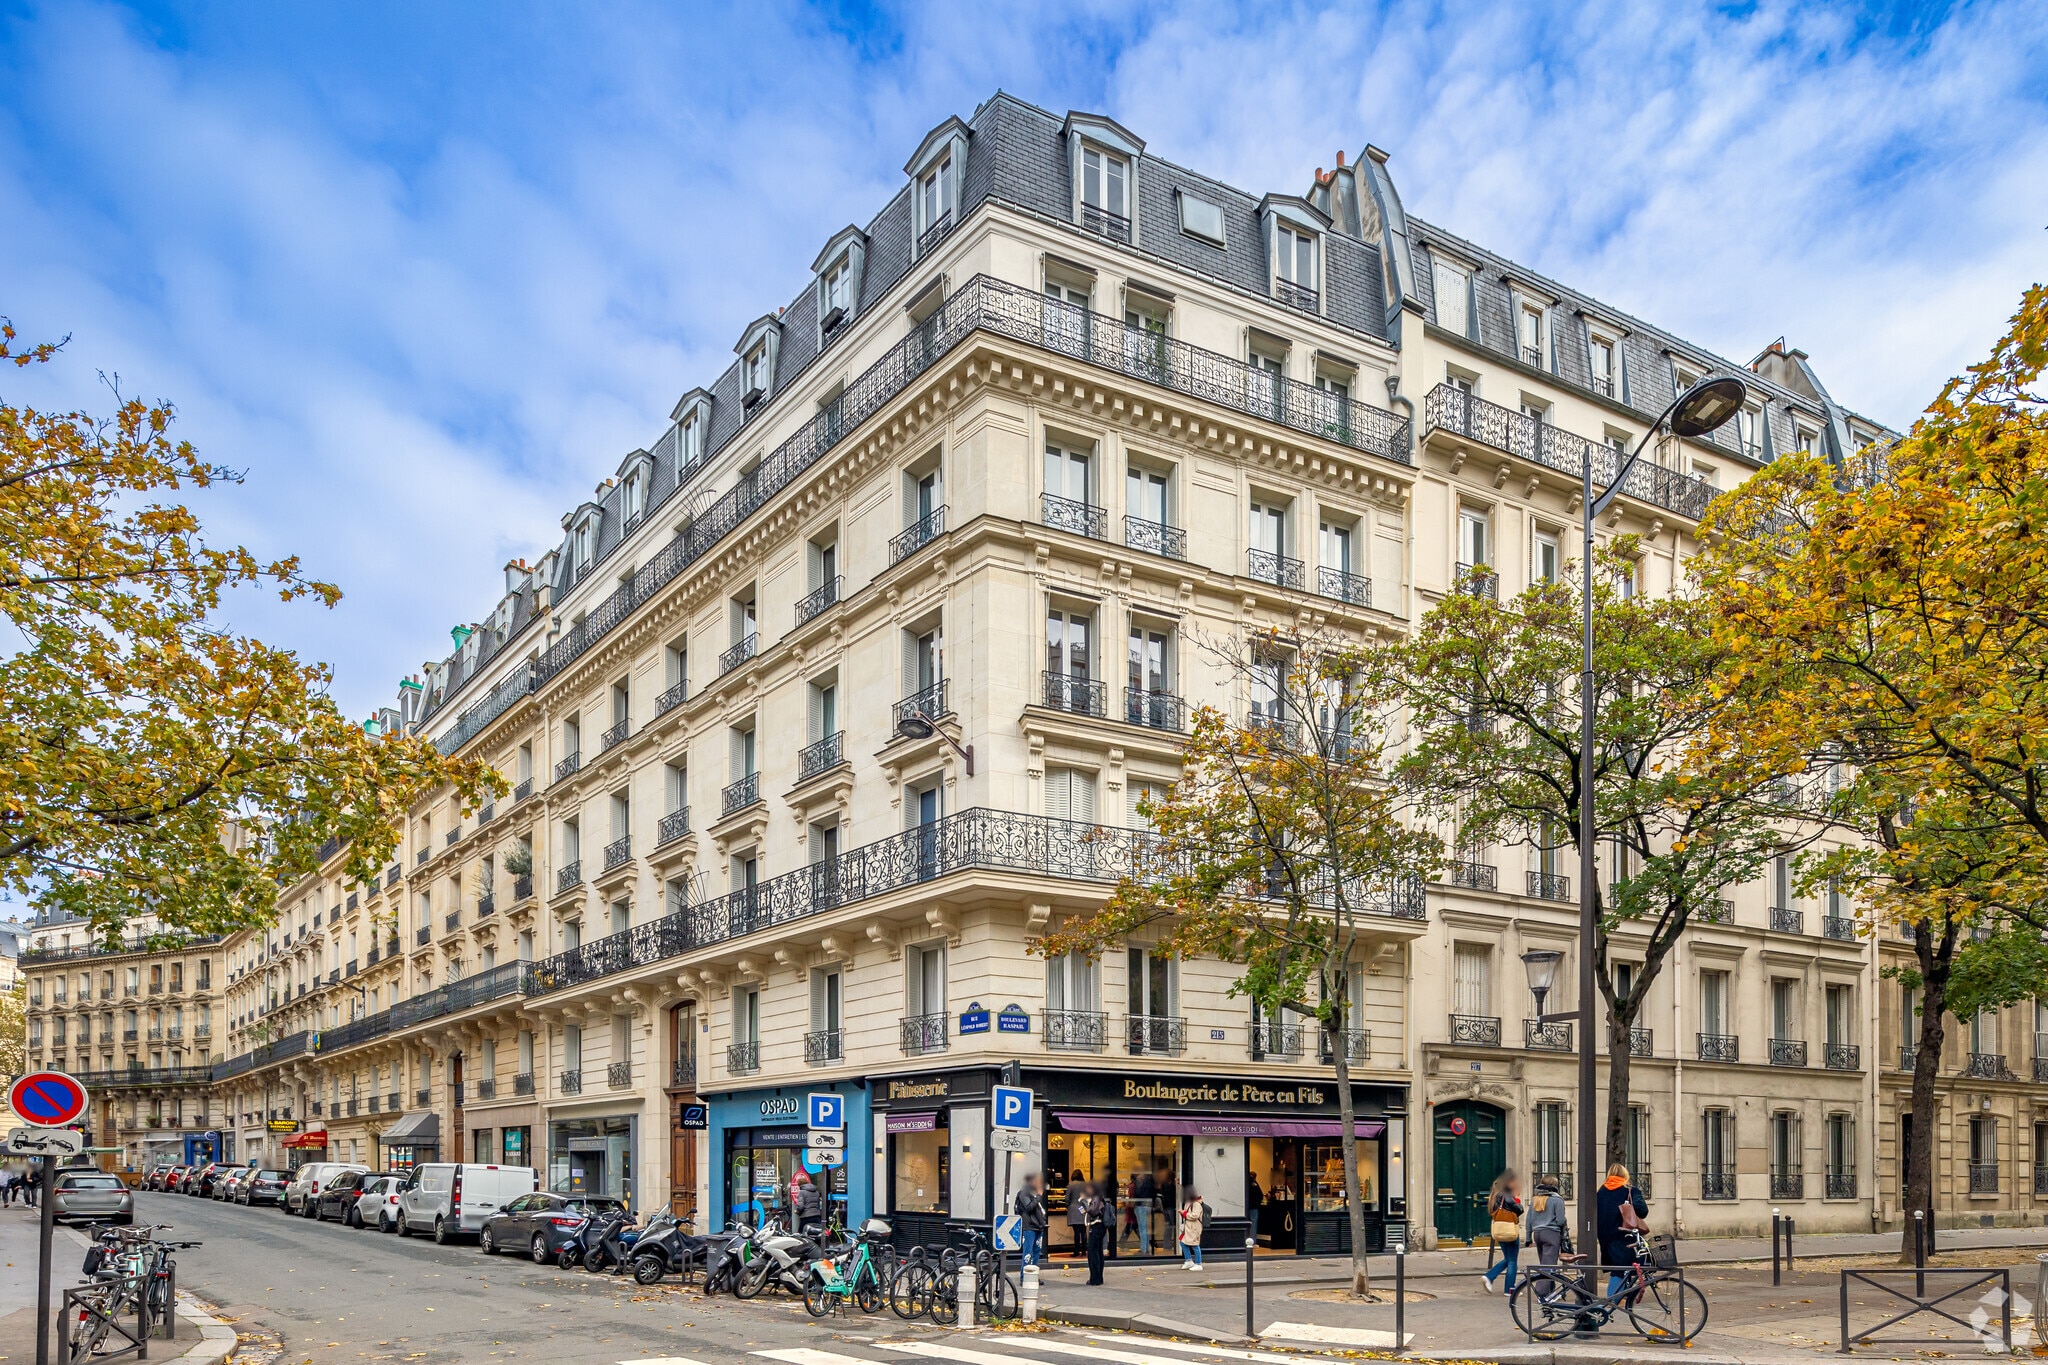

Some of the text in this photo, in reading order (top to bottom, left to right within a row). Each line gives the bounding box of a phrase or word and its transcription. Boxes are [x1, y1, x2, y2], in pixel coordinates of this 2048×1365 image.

[1211, 1030, 1224, 1039] 215
[1124, 1080, 1324, 1105] Boulangerie de Père en Fils
[760, 1098, 799, 1116] OSPAD
[819, 1101, 834, 1122] P
[1004, 1095, 1021, 1120] P
[887, 1122, 906, 1130] MAISON
[1201, 1125, 1229, 1133] MAISON
